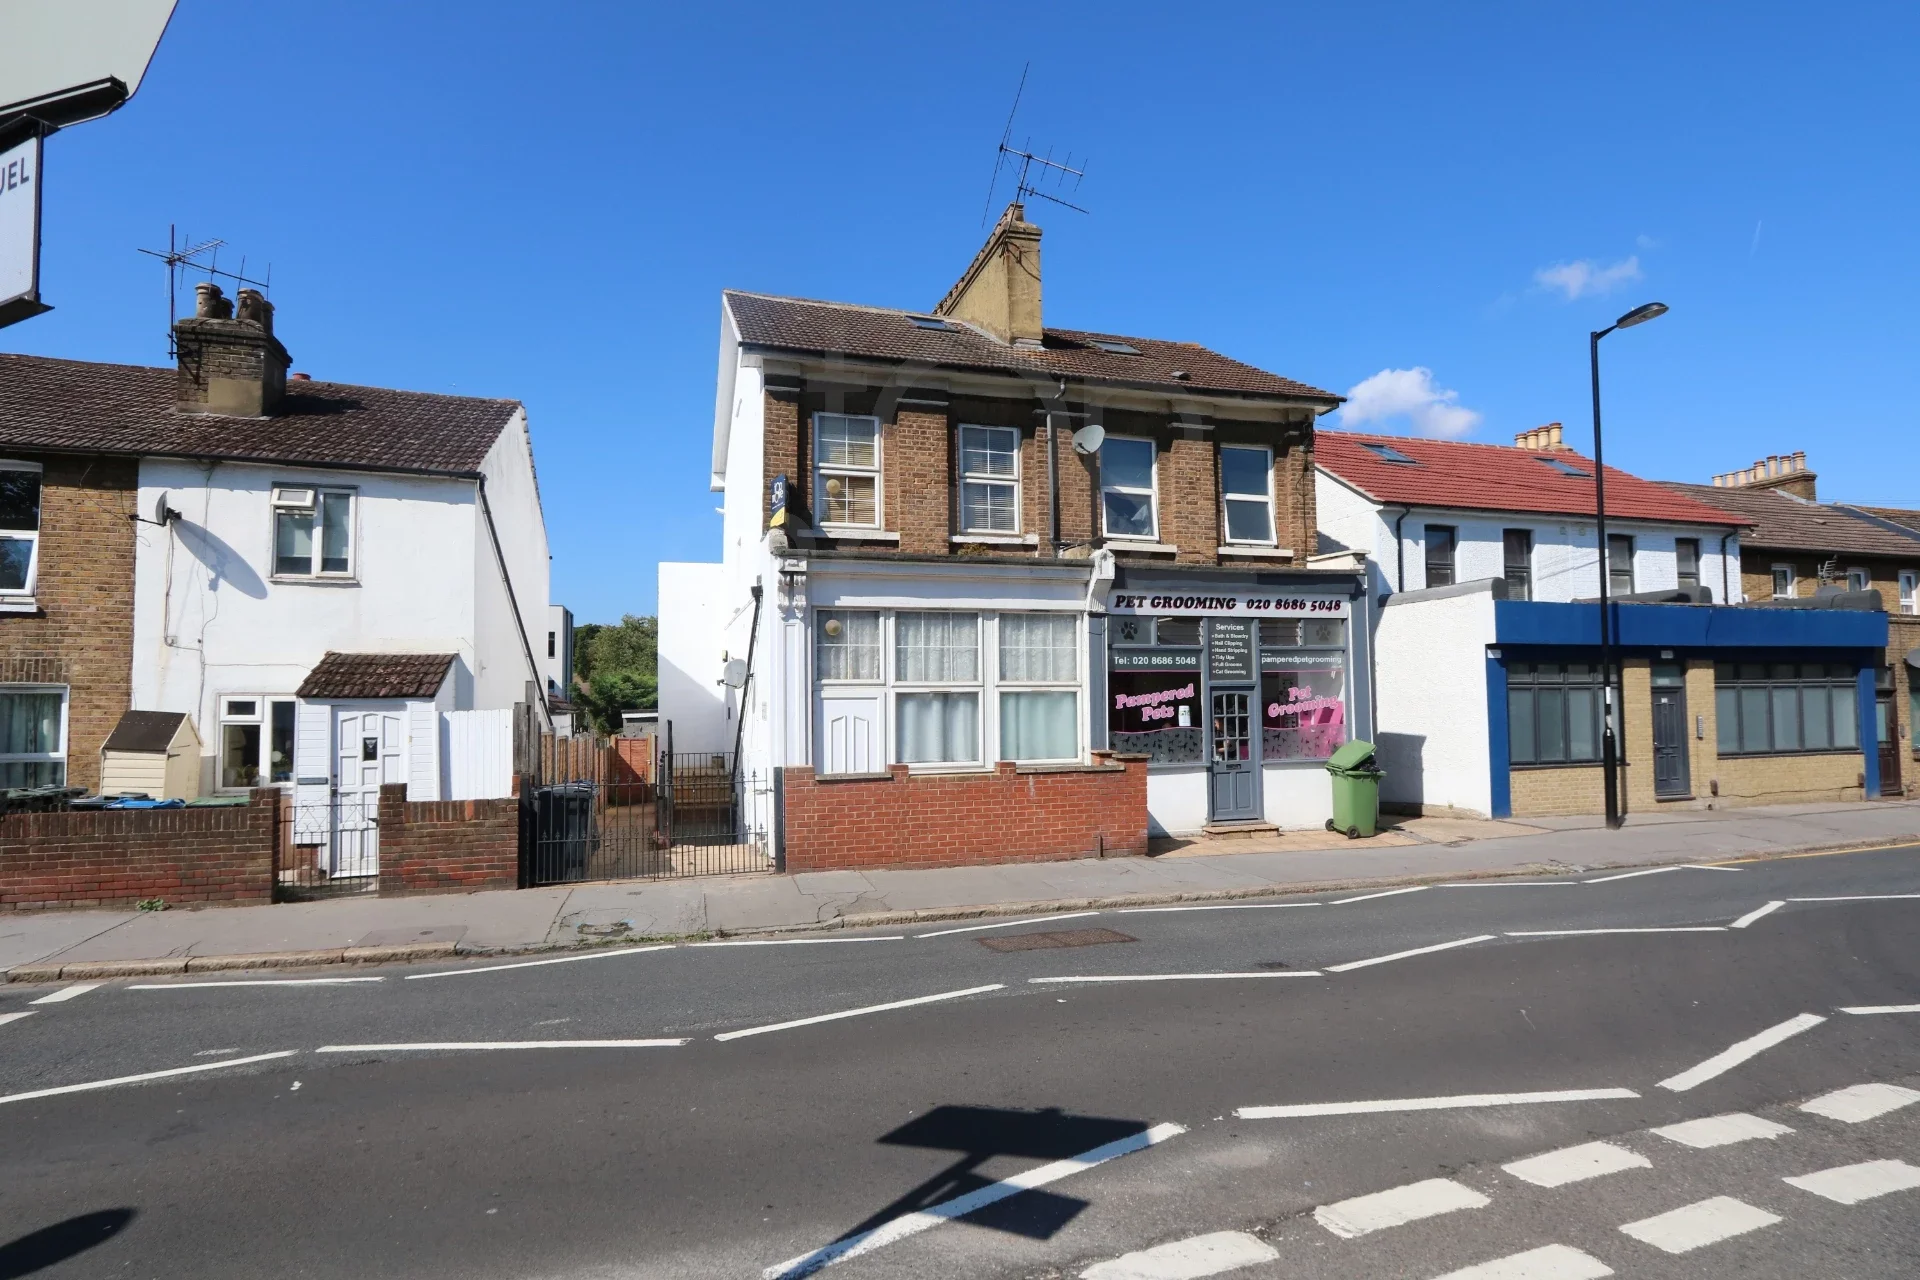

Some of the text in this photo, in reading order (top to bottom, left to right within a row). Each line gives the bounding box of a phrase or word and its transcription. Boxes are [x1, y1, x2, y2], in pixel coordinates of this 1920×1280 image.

[1114, 595, 1342, 612] PET GROOMING 020 8686 5048
[1215, 623, 1245, 631] Services
[1114, 656, 1197, 665] Tel: 020 8686 5048
[1261, 656, 1342, 665] pamperedpetgrooming
[1115, 683, 1194, 709] Pampered
[1288, 685, 1312, 702] Pet
[1141, 705, 1175, 722] Pets
[1267, 695, 1338, 718] Grooming
